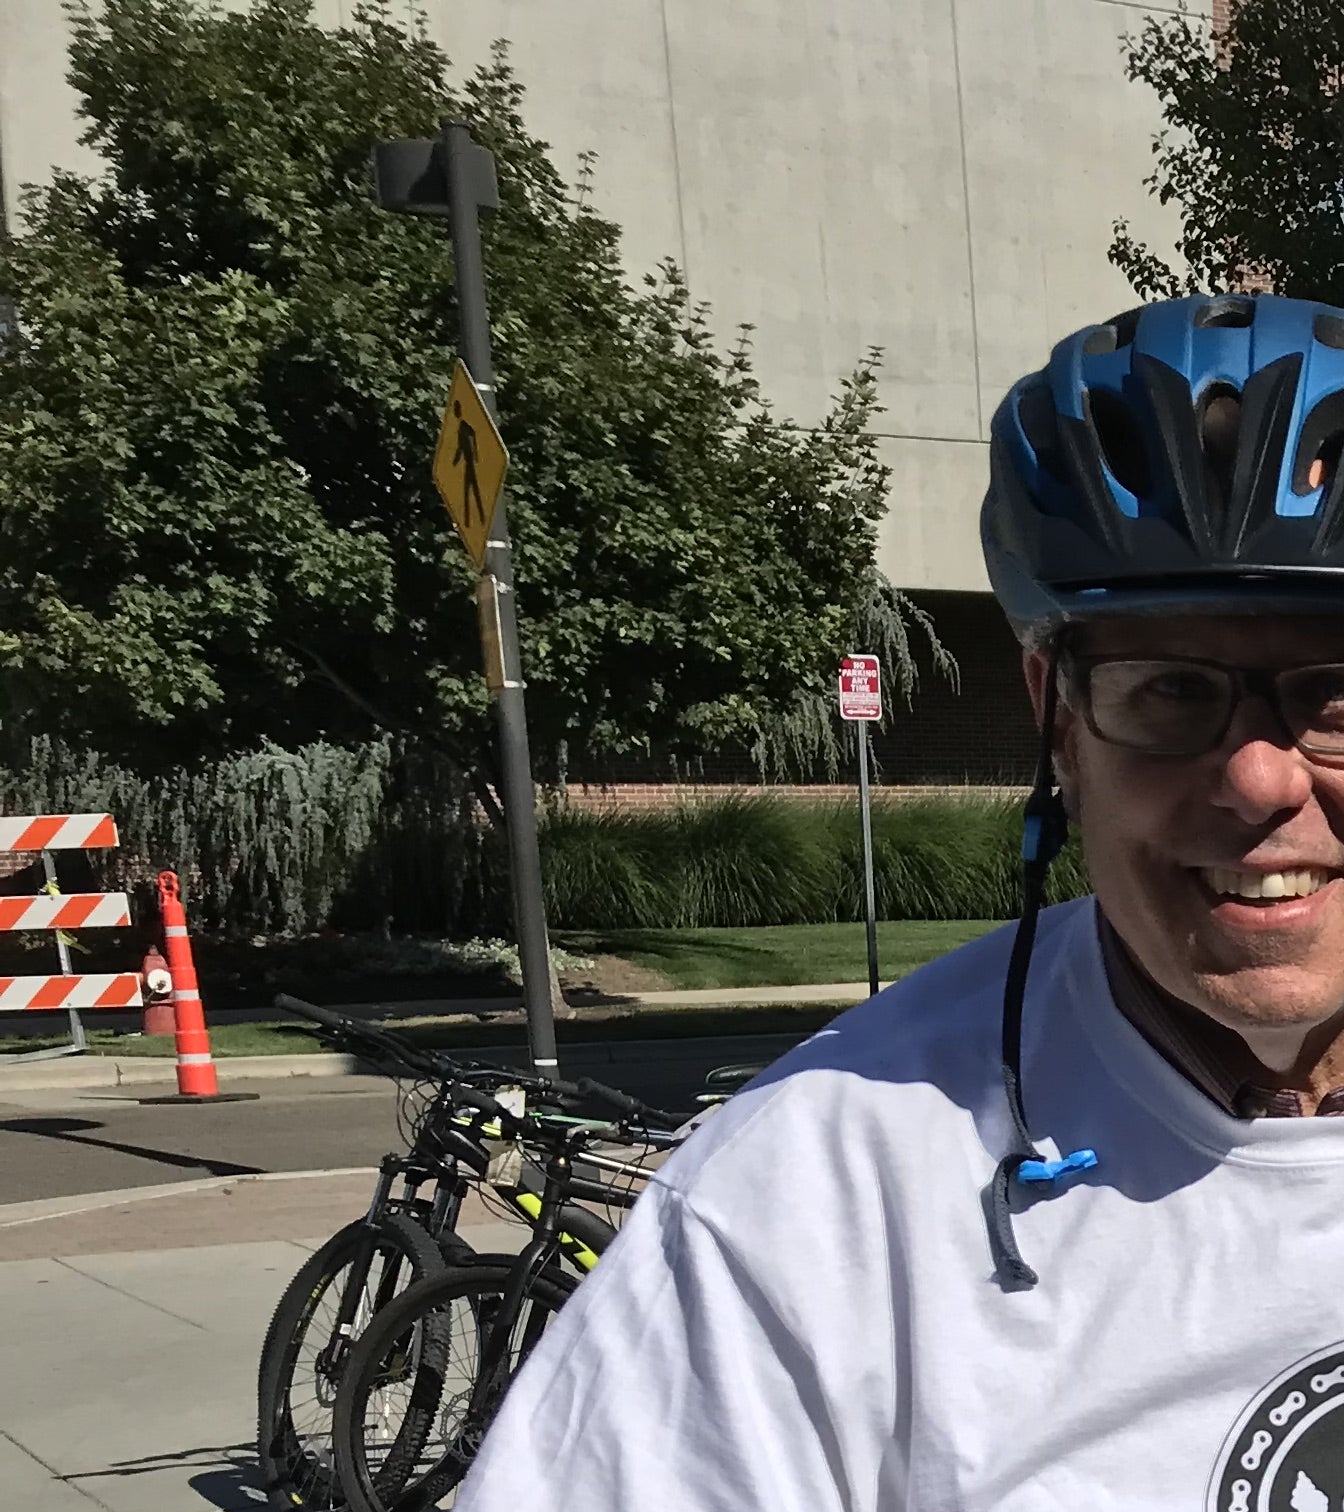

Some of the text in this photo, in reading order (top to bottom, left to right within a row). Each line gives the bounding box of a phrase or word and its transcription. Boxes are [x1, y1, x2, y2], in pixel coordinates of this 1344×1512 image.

[852, 661, 866, 670] NO
[841, 669, 877, 678] PARKING
[851, 677, 869, 685] ANY
[850, 684, 871, 692] TIME
